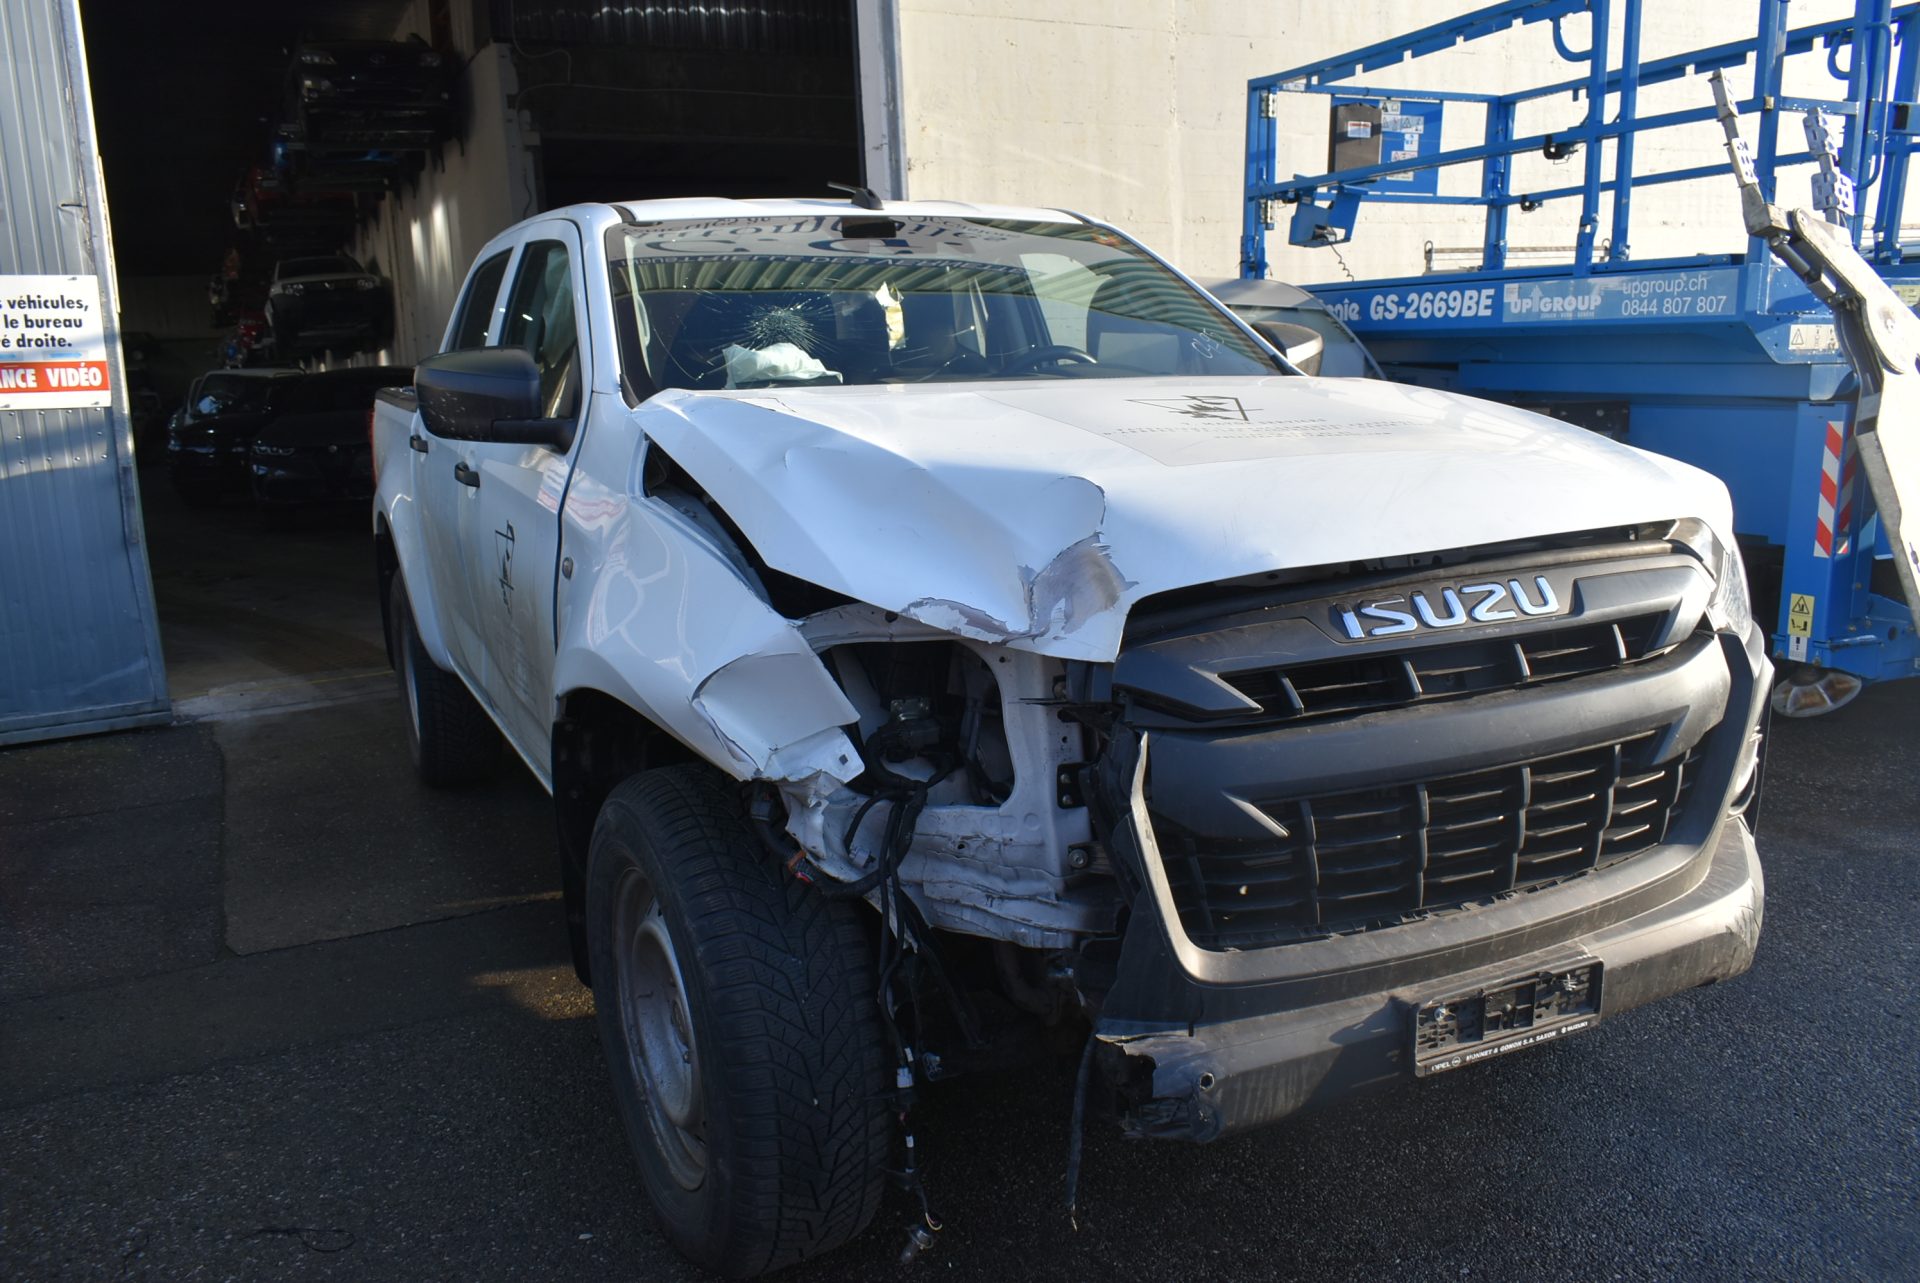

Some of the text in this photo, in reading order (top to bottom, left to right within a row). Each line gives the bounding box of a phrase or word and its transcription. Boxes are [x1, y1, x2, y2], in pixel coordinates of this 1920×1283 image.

[1622, 274, 1708, 298] upgroup.ch
[7, 294, 89, 312] véhicules,
[1370, 288, 1495, 321] GS-2669BE
[1621, 295, 1727, 316] 0844 807 807
[4, 314, 83, 329] le bureau
[16, 333, 73, 348] droite.
[45, 362, 103, 388] VIDÉO
[1334, 575, 1561, 639] ISUZU
